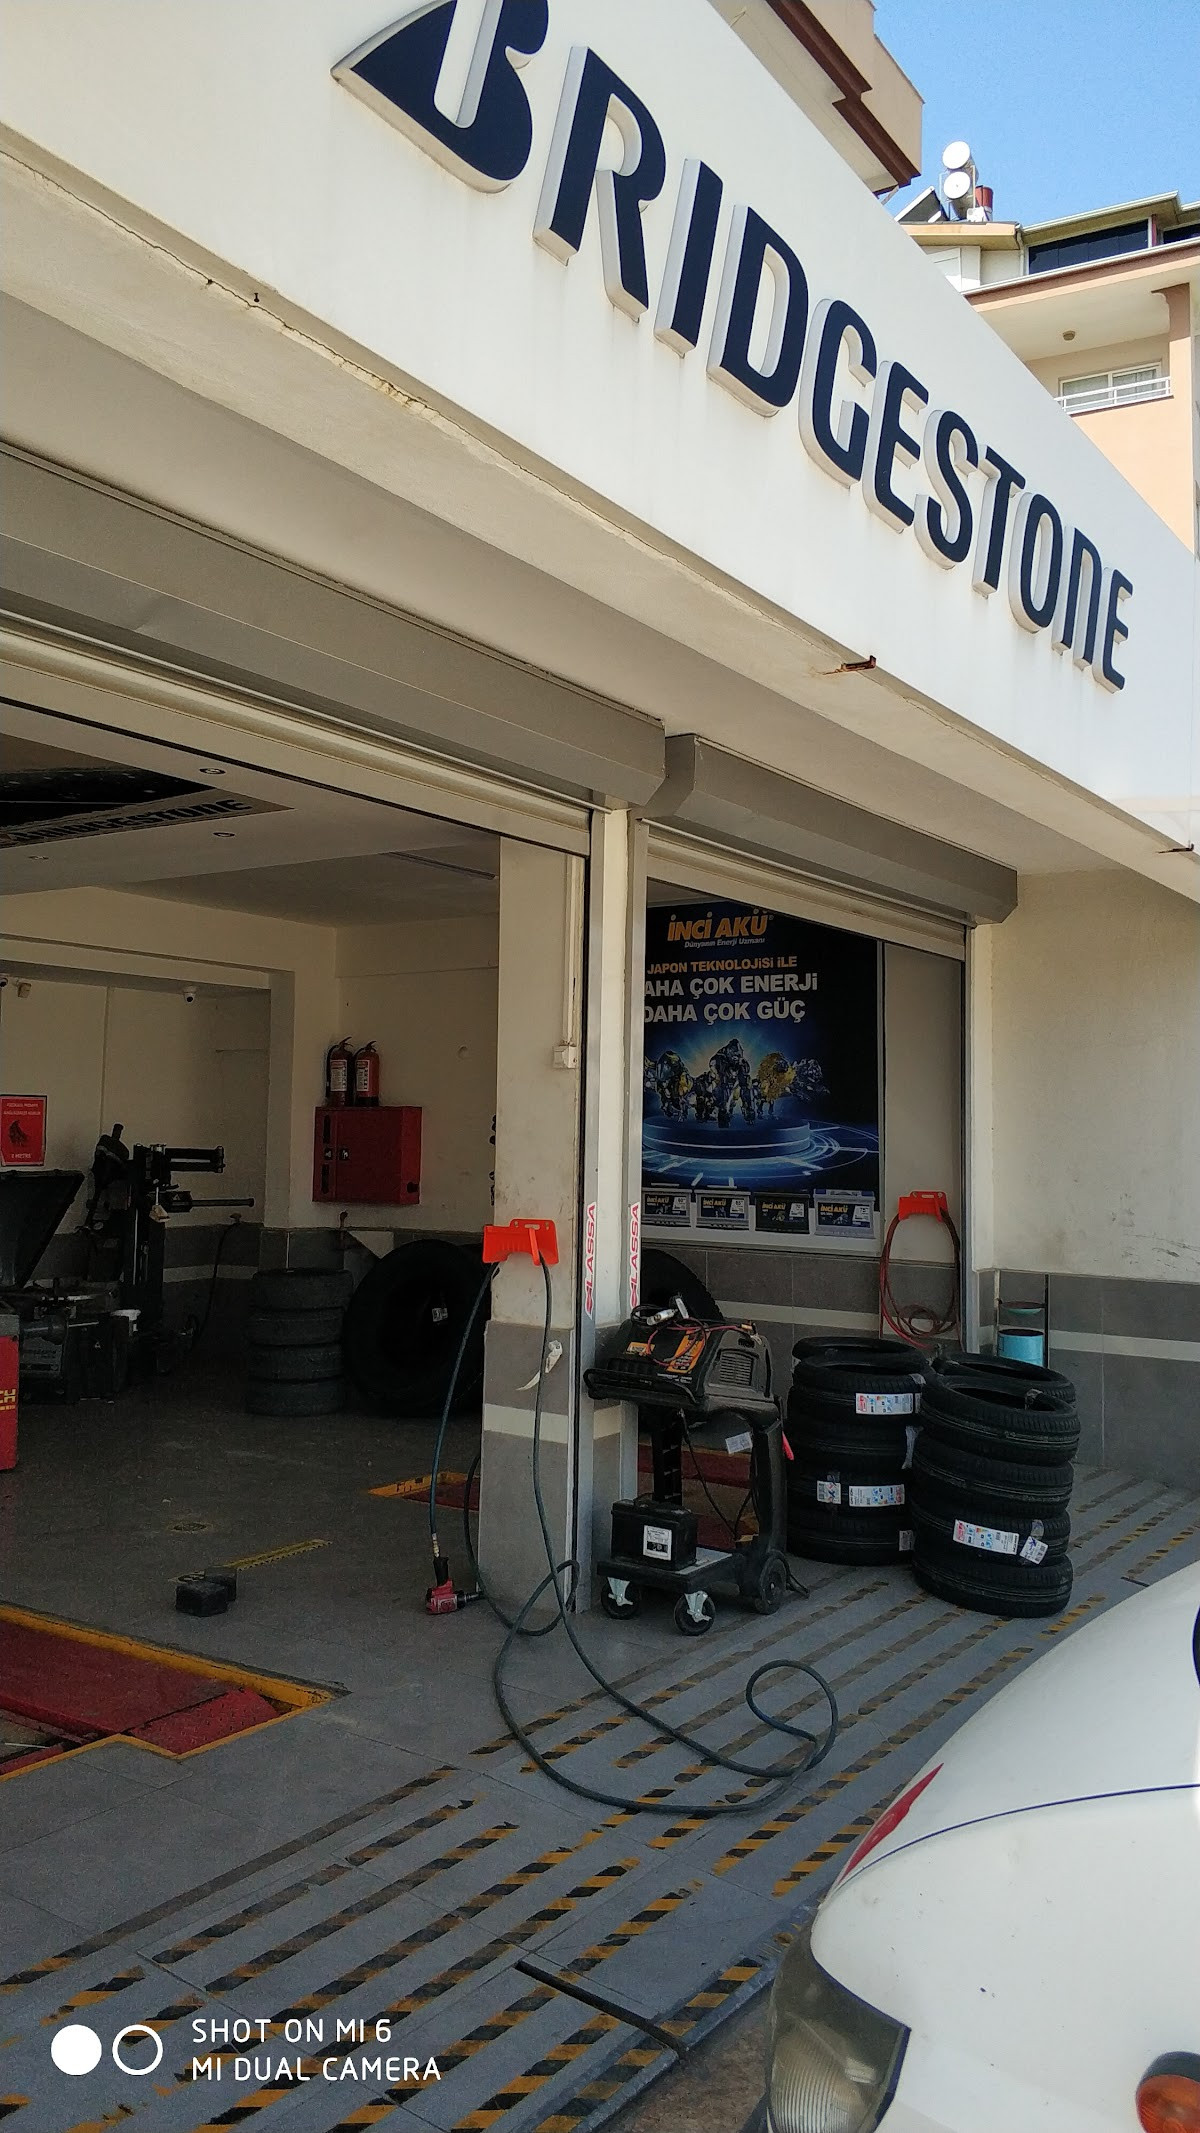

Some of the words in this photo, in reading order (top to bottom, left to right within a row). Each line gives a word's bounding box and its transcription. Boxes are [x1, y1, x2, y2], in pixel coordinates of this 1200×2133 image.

[334, 0, 1134, 693] BRIDGESTONE
[717, 938, 738, 947] Enerji
[647, 962, 688, 975] JAPON
[689, 977, 734, 1000] ÇOK
[703, 1002, 751, 1026] ÇOK
[756, 996, 806, 1023] GÜÇ
